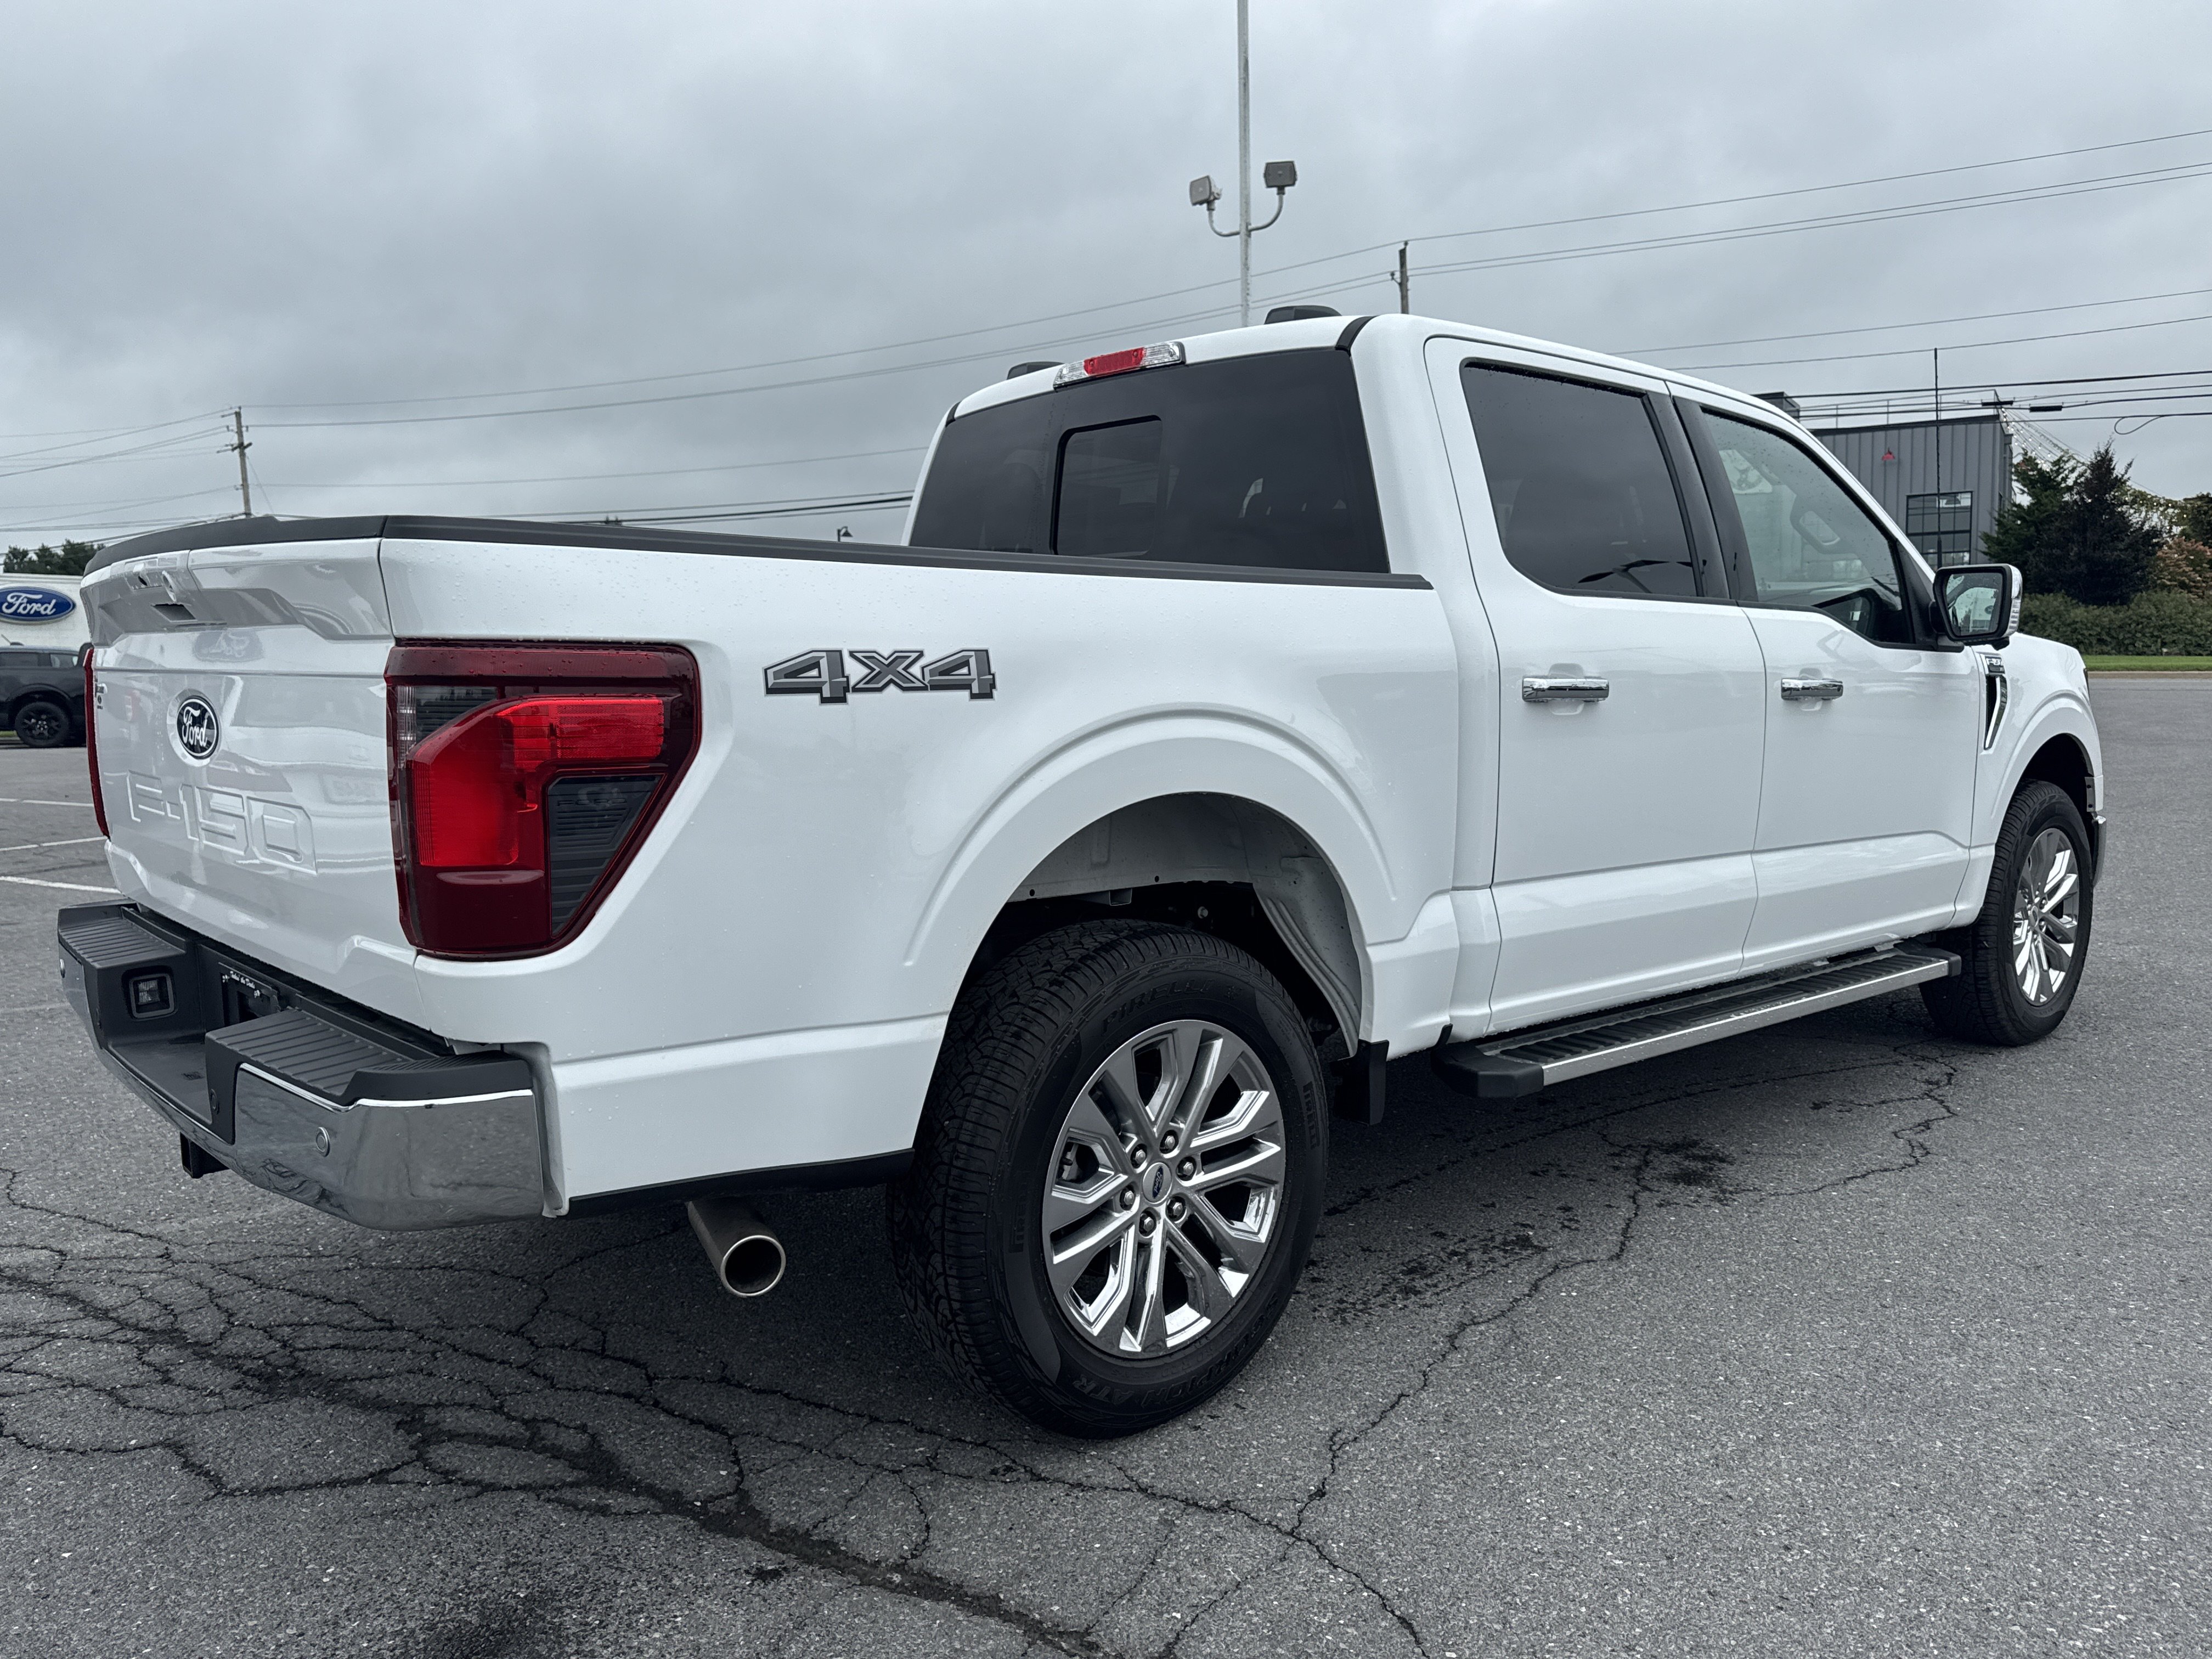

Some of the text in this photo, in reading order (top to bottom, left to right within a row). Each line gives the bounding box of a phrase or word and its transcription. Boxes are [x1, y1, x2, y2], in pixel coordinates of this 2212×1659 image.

[2, 592, 57, 615] Ford
[182, 706, 209, 747] Ford
[126, 769, 318, 876] F-150
[1102, 979, 1215, 1036] PIRELLI
[1072, 1374, 1135, 1406] ATR
